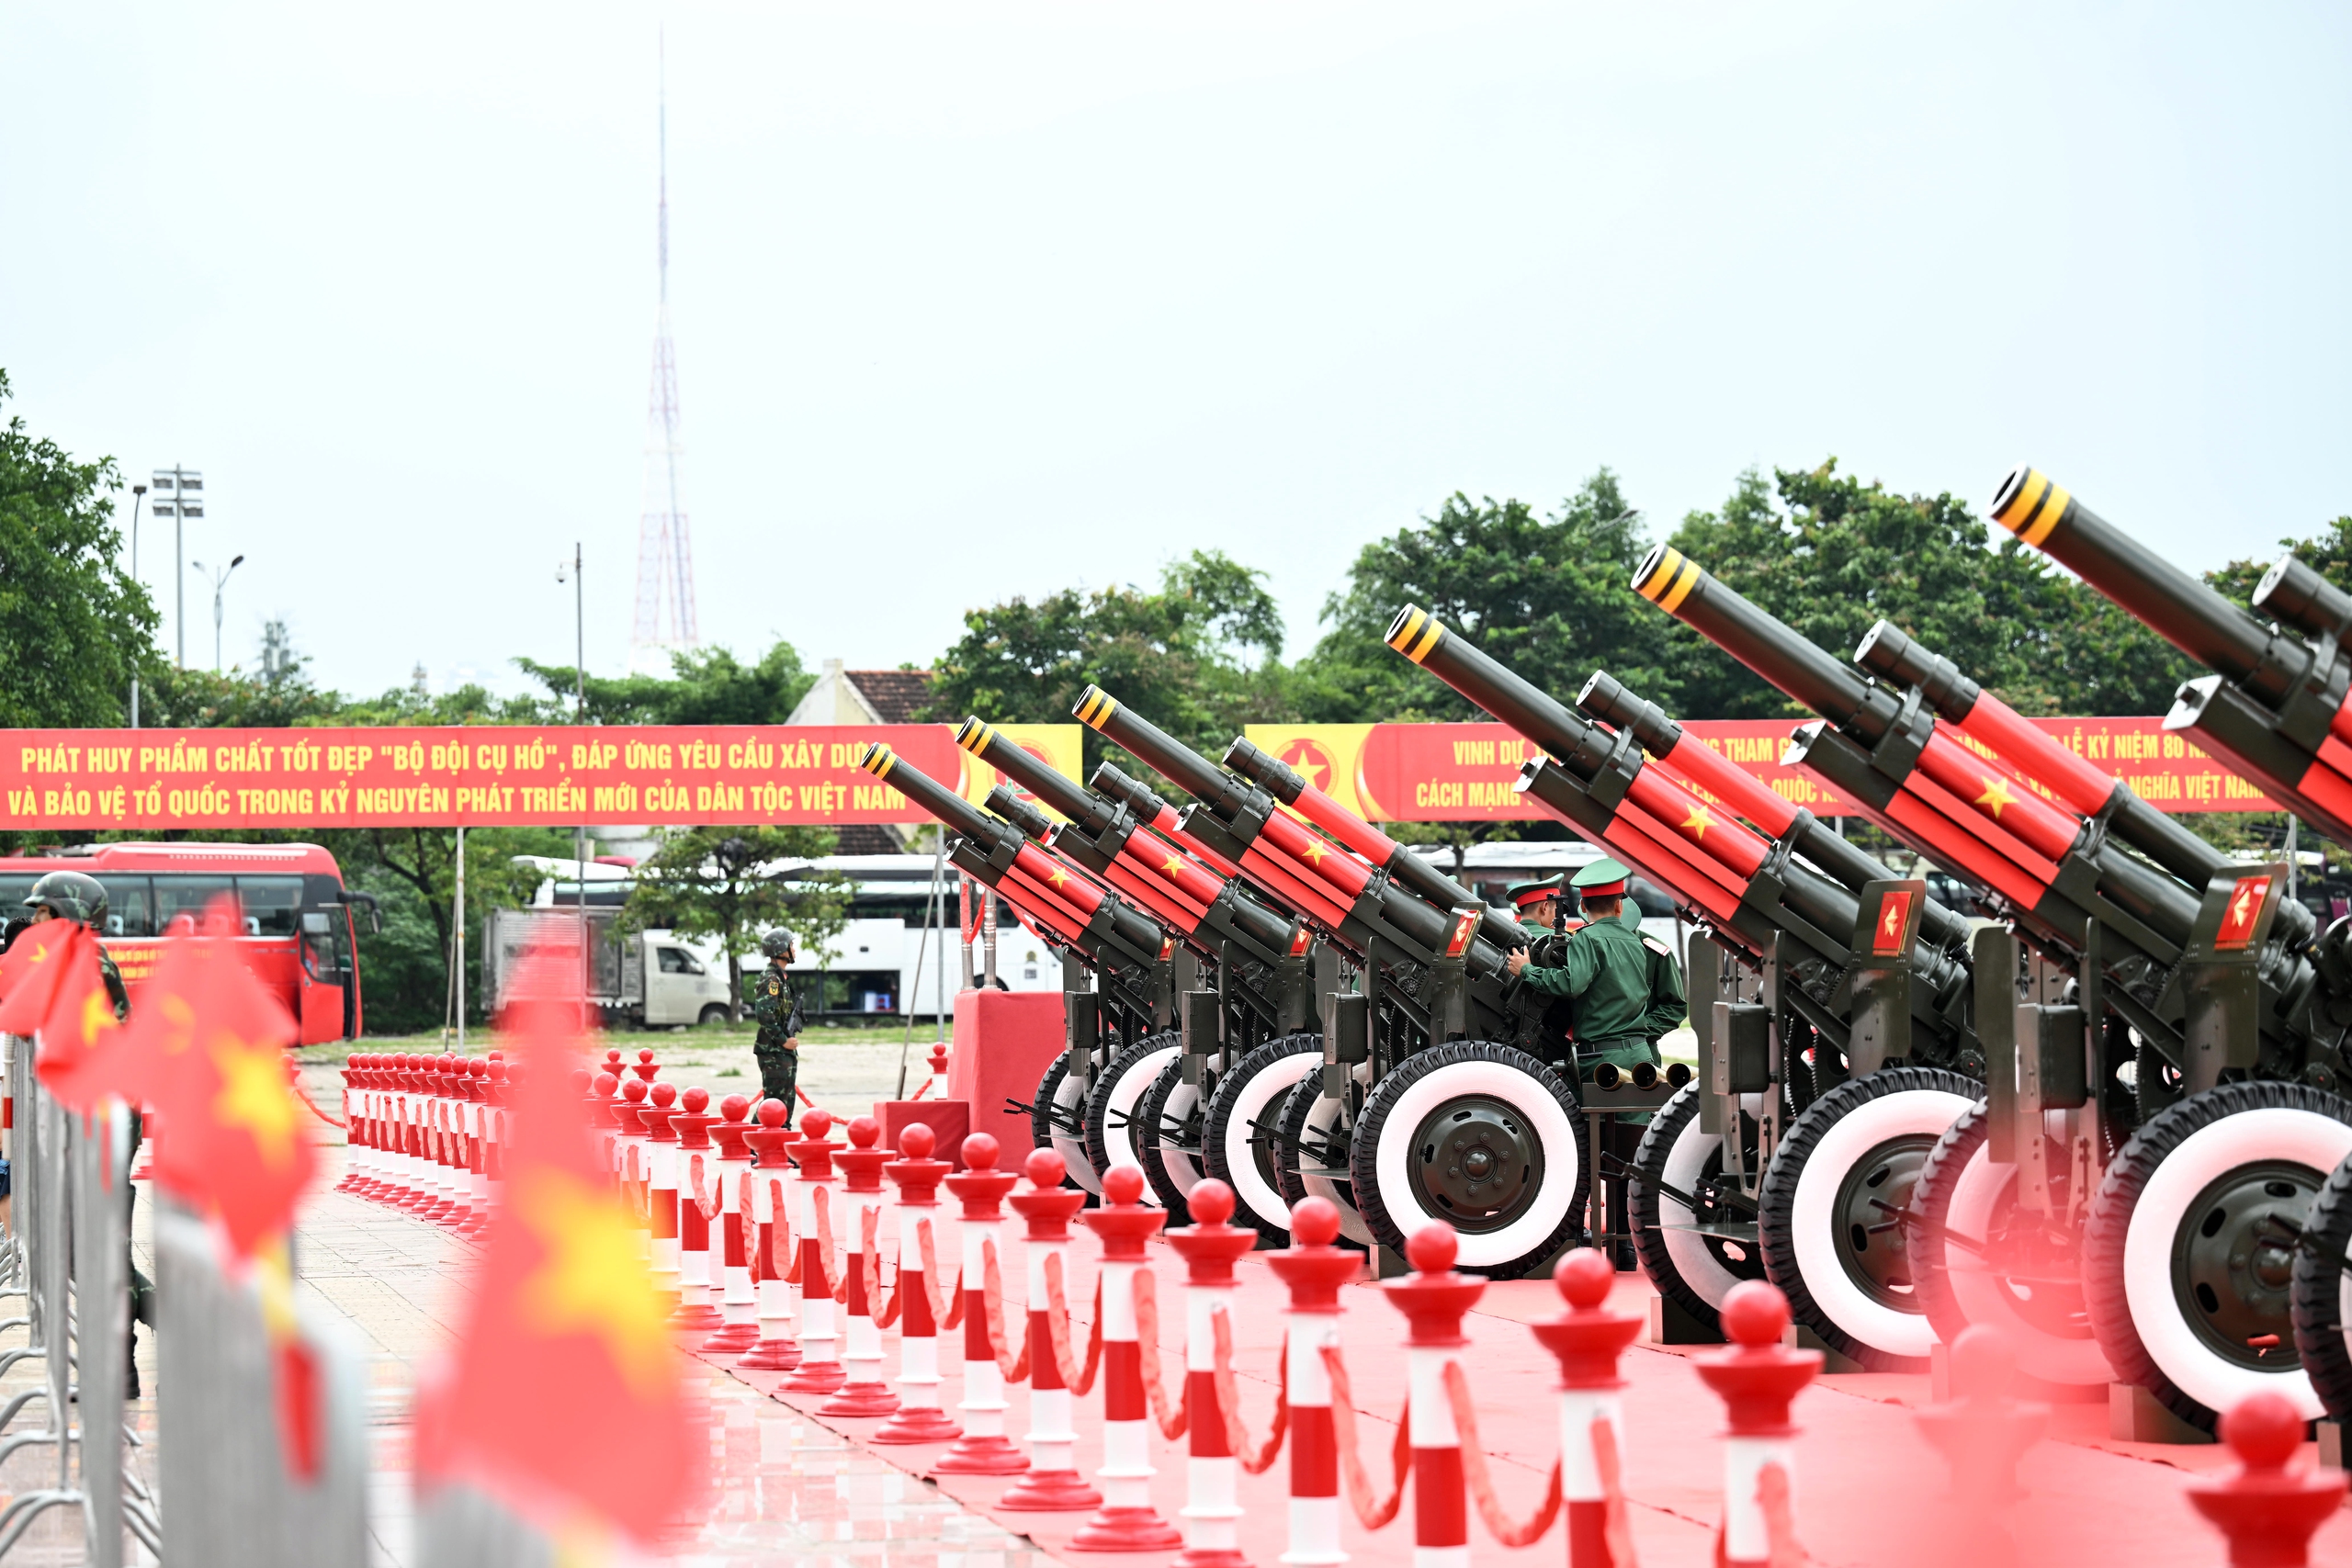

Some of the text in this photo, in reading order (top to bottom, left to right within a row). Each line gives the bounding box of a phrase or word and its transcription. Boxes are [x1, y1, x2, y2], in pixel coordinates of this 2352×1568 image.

[21, 743, 82, 773] PHÁT
[87, 747, 133, 773] HUY
[140, 738, 209, 773] PHẨM
[215, 738, 275, 773] CHẤT
[280, 738, 322, 772] TỐT
[327, 745, 373, 777] ĐẸP
[380, 740, 424, 776] "BỘ
[430, 740, 469, 776] ĐỘI
[476, 744, 508, 776] CỤ
[571, 739, 618, 770] ĐÁP
[624, 739, 673, 770] ỨNG
[678, 739, 721, 770] YÊU
[728, 737, 774, 770] CẦU
[780, 739, 824, 769] XÂY
[1453, 740, 1496, 765] VINH
[1724, 737, 1774, 762] THAM
[2087, 727, 2110, 760] KỶ
[2114, 729, 2159, 764] NIỆM
[2163, 734, 2185, 759] 80
[7, 777, 907, 821] VÀ BẢO VỆ TỔ QUỐC TRONG KỶ NGUYÊN PHÁT TRIỂN MỚI CỦA DÂN TỘC VIỆT NAM
[1416, 777, 1464, 807] CÁCH
[1467, 782, 1521, 812] MẠNG
[2128, 771, 2181, 800] NGHĨA
[2185, 770, 2222, 805] VIỆT
